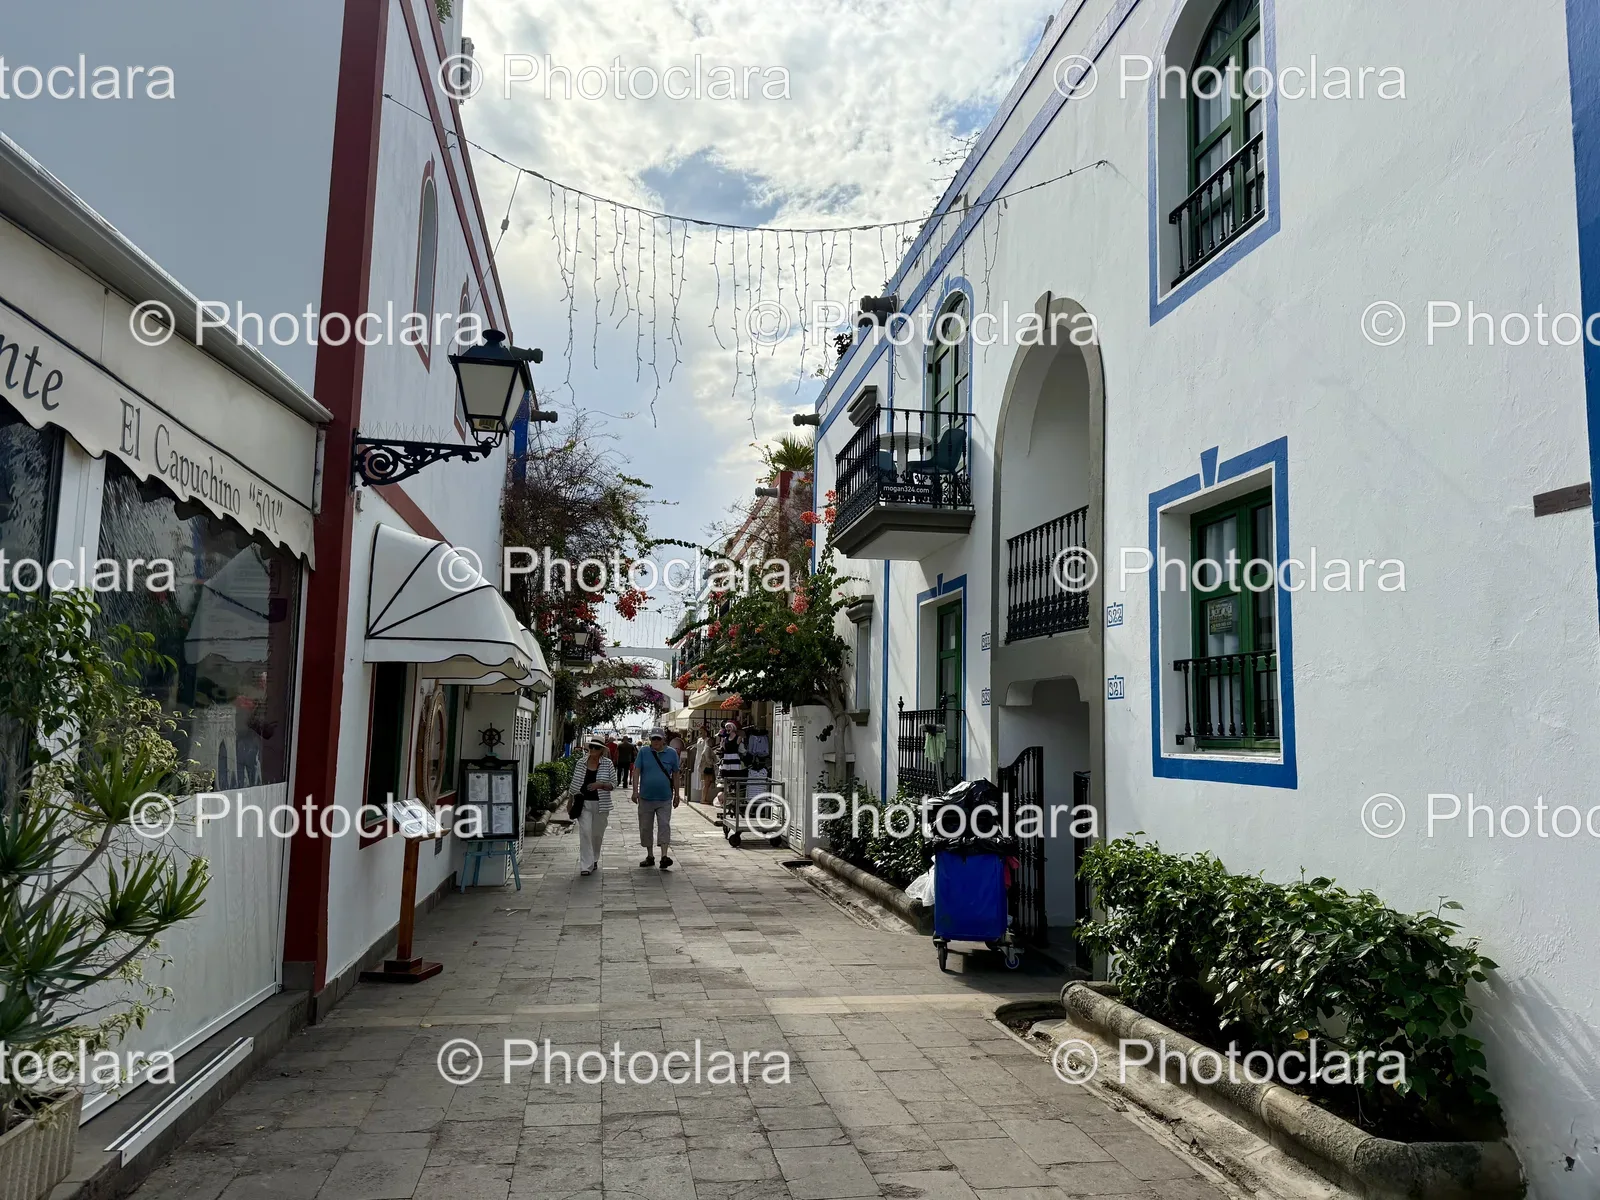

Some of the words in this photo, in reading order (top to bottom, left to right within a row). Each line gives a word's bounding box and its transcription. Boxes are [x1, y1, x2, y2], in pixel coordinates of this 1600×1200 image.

[119, 398, 141, 461] El
[154, 424, 240, 515] Capuchino
[883, 485, 930, 494] mogan324.com
[1109, 680, 1123, 697] 321
